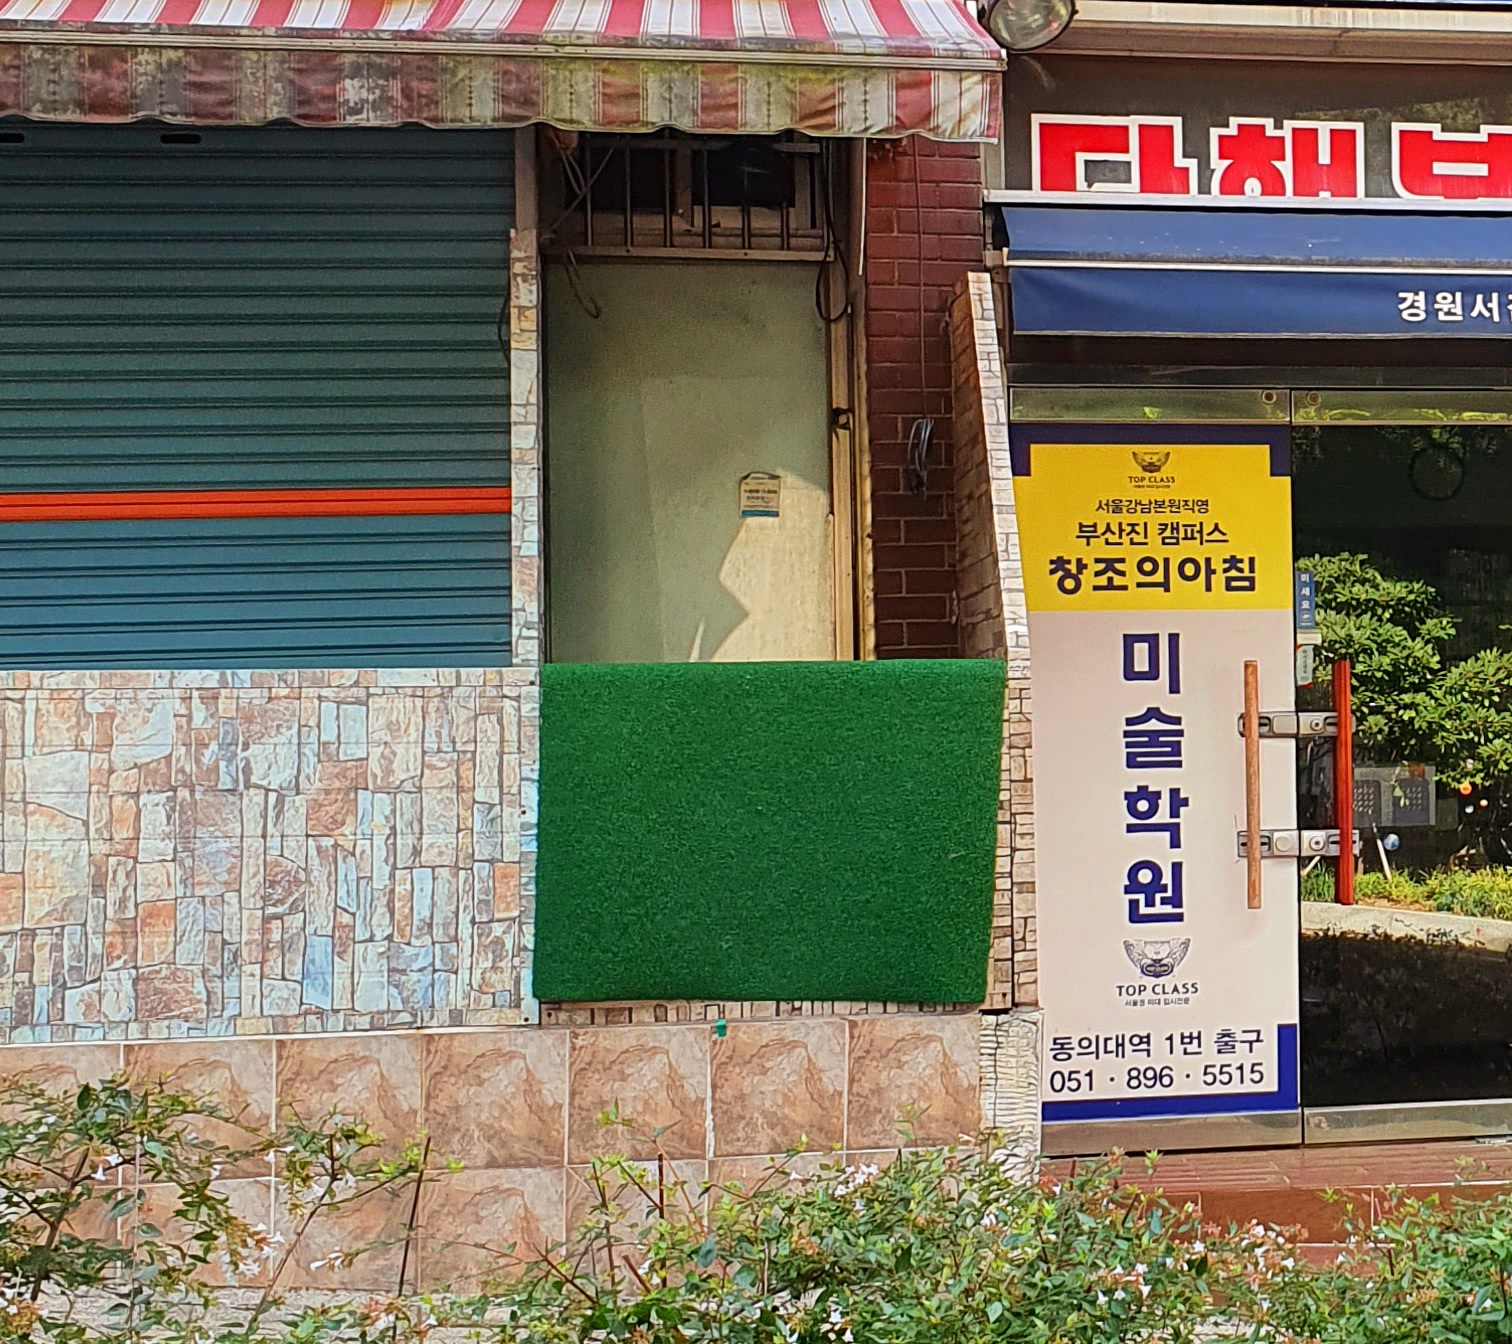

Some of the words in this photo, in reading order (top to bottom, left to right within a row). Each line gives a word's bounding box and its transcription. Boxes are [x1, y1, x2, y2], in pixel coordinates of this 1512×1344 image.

[1128, 475, 1146, 484] TOP
[1148, 475, 1176, 484] CLASS
[1075, 521, 1149, 546] 부산진
[1157, 521, 1230, 546] 캠퍼스
[1048, 554, 1257, 595] 창조의아침
[1121, 632, 1190, 925] 미술학원
[1115, 984, 1147, 997] TOP
[1151, 982, 1199, 995] CLASS
[1049, 1032, 1152, 1062] 동의대역
[1164, 1030, 1204, 1056] 1번
[1213, 1028, 1265, 1054] 출구
